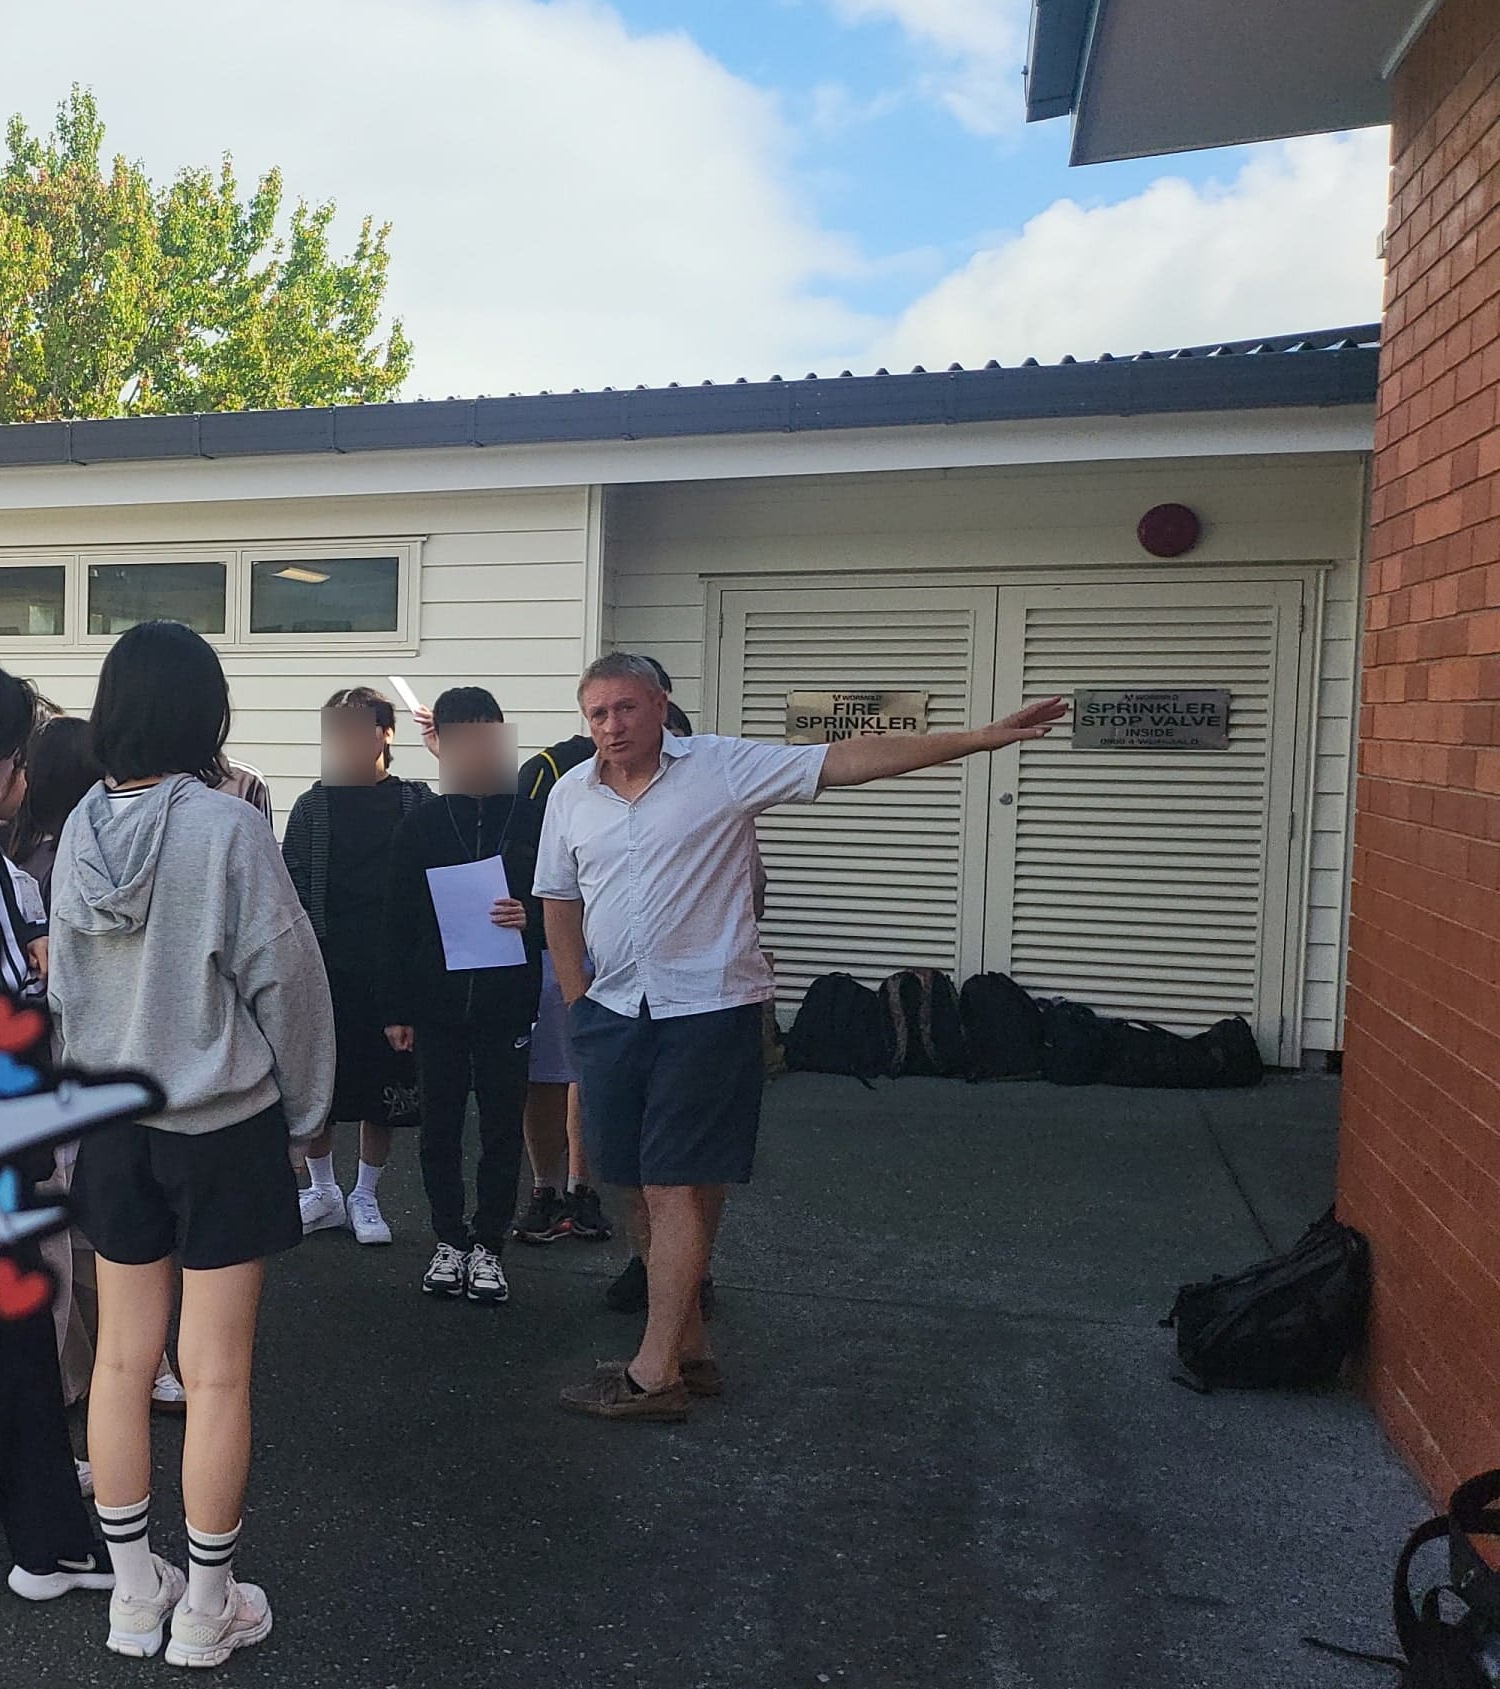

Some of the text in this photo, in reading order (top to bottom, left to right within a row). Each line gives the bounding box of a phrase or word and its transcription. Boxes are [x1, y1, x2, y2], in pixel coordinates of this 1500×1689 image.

[833, 703, 880, 715] FIRE
[1086, 703, 1216, 714] SPRINKLER
[795, 716, 917, 729] SPRINKLER
[1081, 715, 1221, 727] STOP VALVE
[1125, 728, 1174, 737] INSIDE
